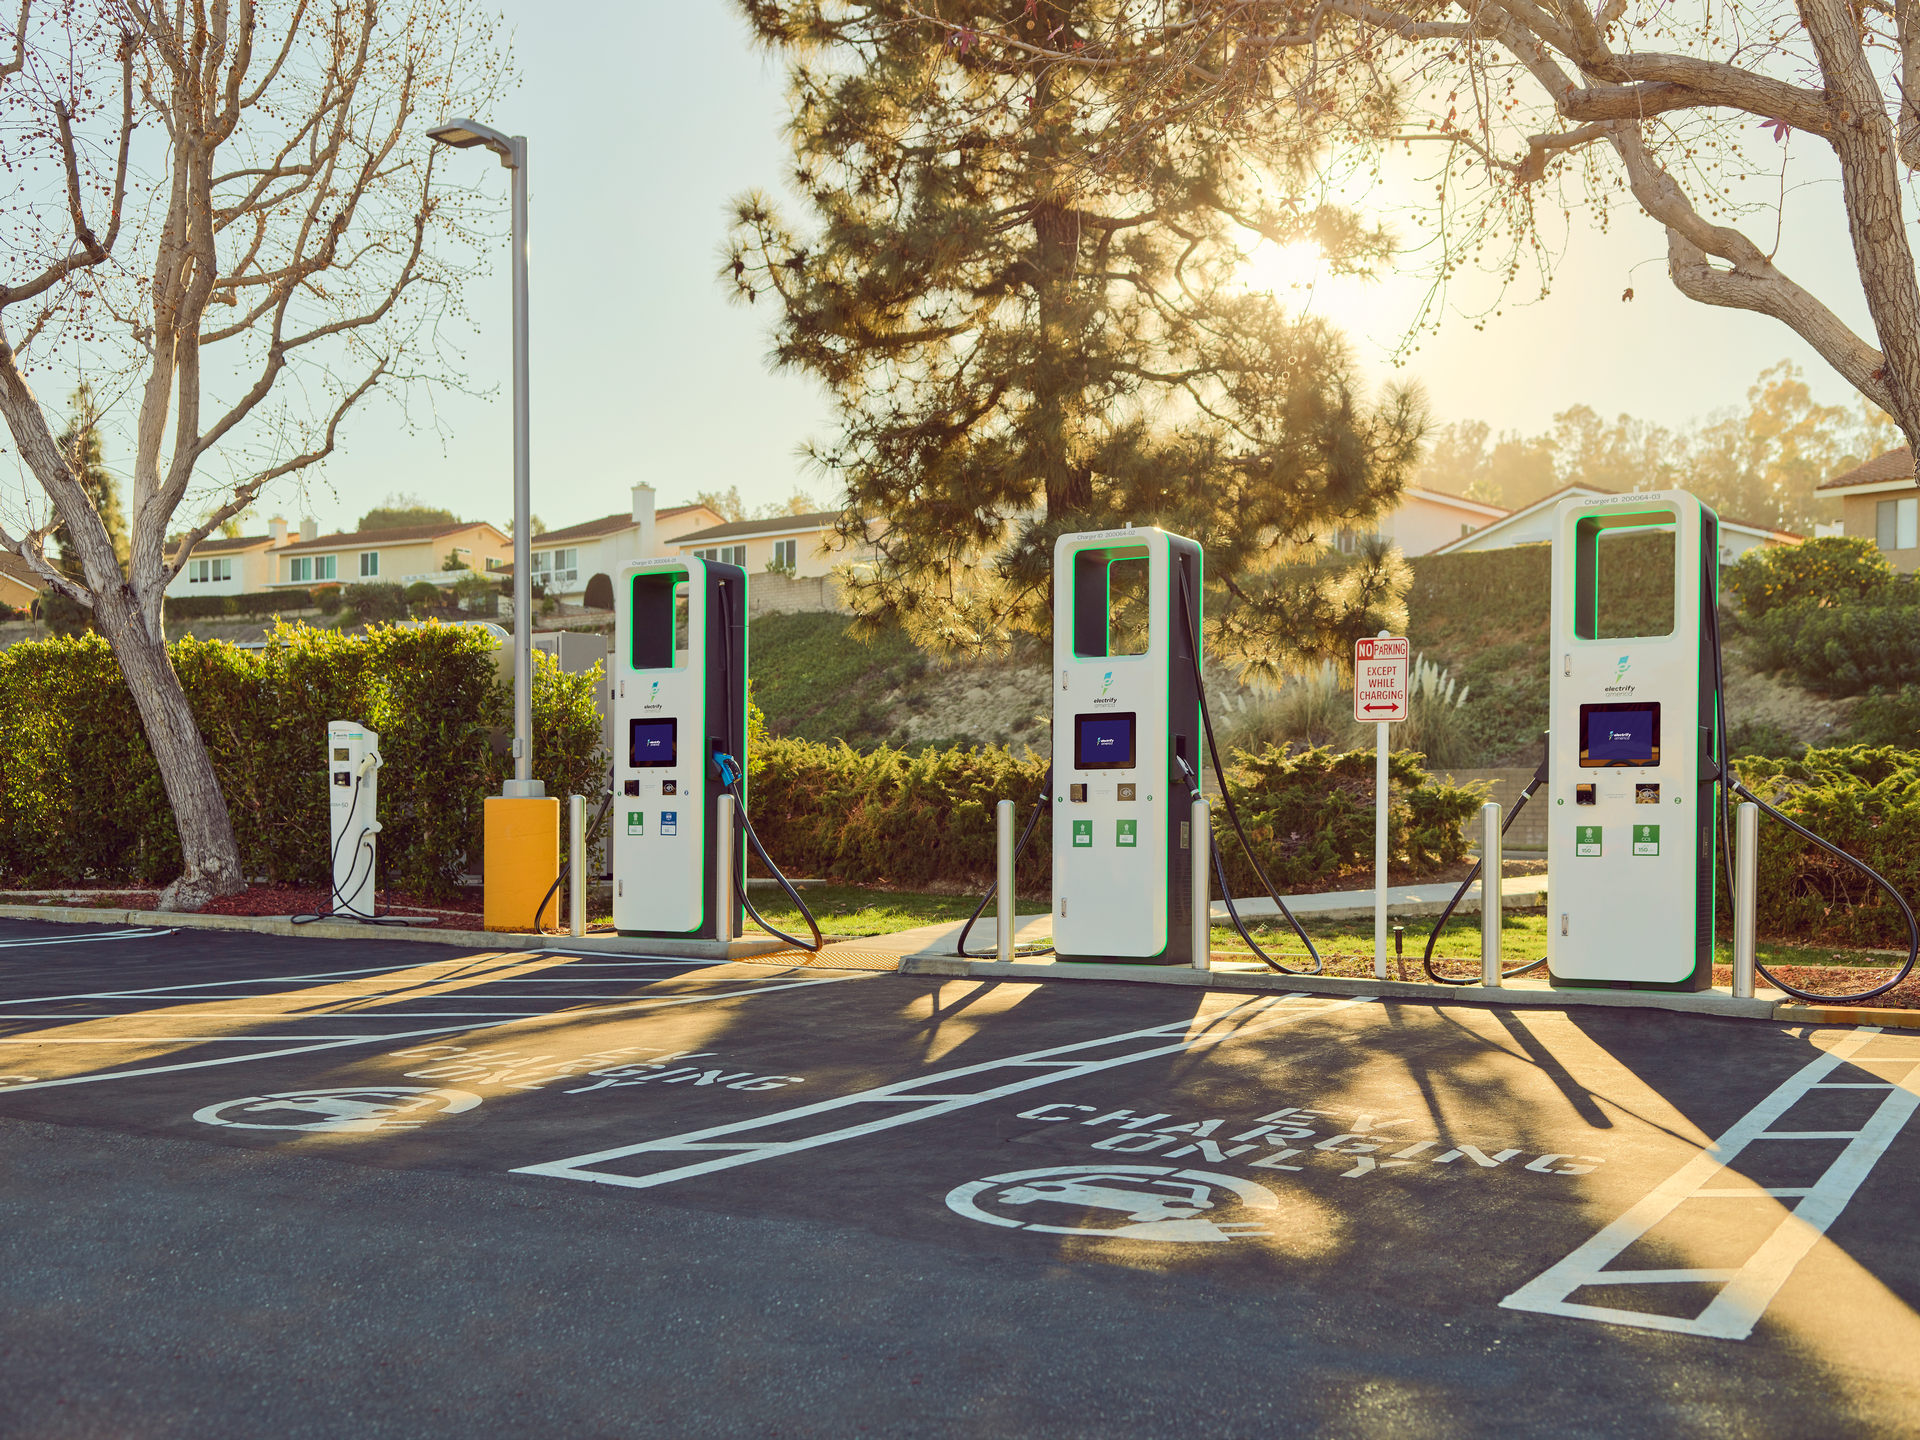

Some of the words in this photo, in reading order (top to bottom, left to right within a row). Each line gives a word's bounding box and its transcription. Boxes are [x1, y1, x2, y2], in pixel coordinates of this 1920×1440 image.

[1584, 497, 1609, 505] Charger
[1621, 494, 1661, 502] 200064-03
[1359, 643, 1373, 657] NO
[1374, 643, 1406, 656] PARKING
[1367, 666, 1397, 676] EXCEPT
[1368, 678, 1395, 688] WHILE
[1359, 690, 1403, 700] CHARGING
[582, 1046, 719, 1063] EV
[389, 1045, 806, 1091] CHARGING
[403, 1065, 648, 1095] ONLY
[1253, 1107, 1415, 1133] EV
[1016, 1103, 1606, 1176] CHARGING
[1091, 1132, 1419, 1179] ONLY
